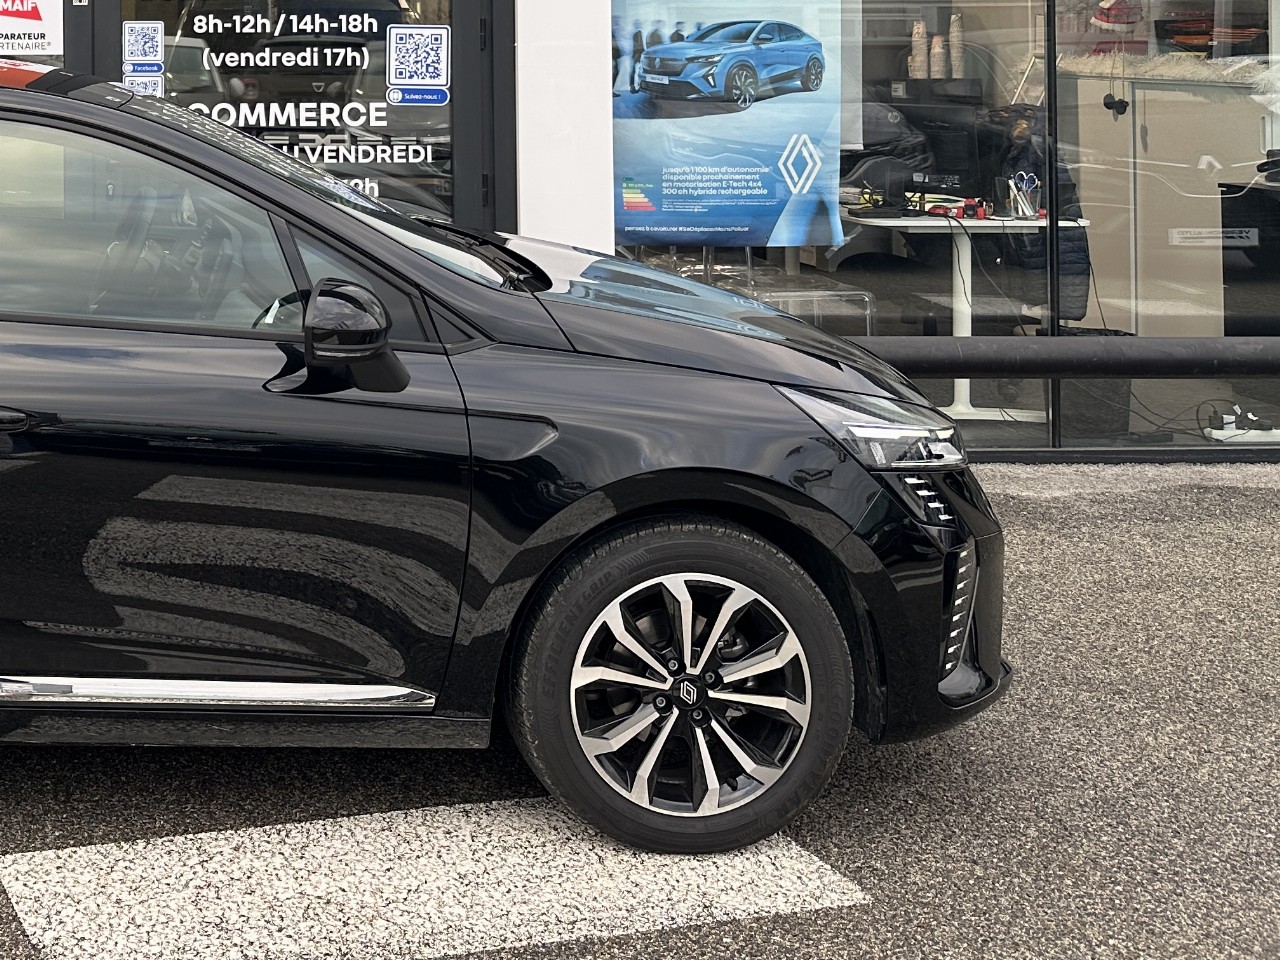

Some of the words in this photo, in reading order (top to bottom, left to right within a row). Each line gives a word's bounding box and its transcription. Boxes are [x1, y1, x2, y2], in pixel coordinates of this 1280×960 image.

[193, 14, 271, 34] 8h-12h
[273, 13, 286, 37] /
[289, 14, 378, 33] 14h-18h
[202, 47, 318, 70] (vendredi
[323, 47, 370, 70] 17h)
[303, 145, 432, 164] VENDREDI
[662, 166, 690, 175] jusqu'à
[662, 173, 701, 181] disponible
[702, 173, 760, 181] prochainement
[689, 187, 717, 196] hybride
[717, 188, 768, 196] rechargeable
